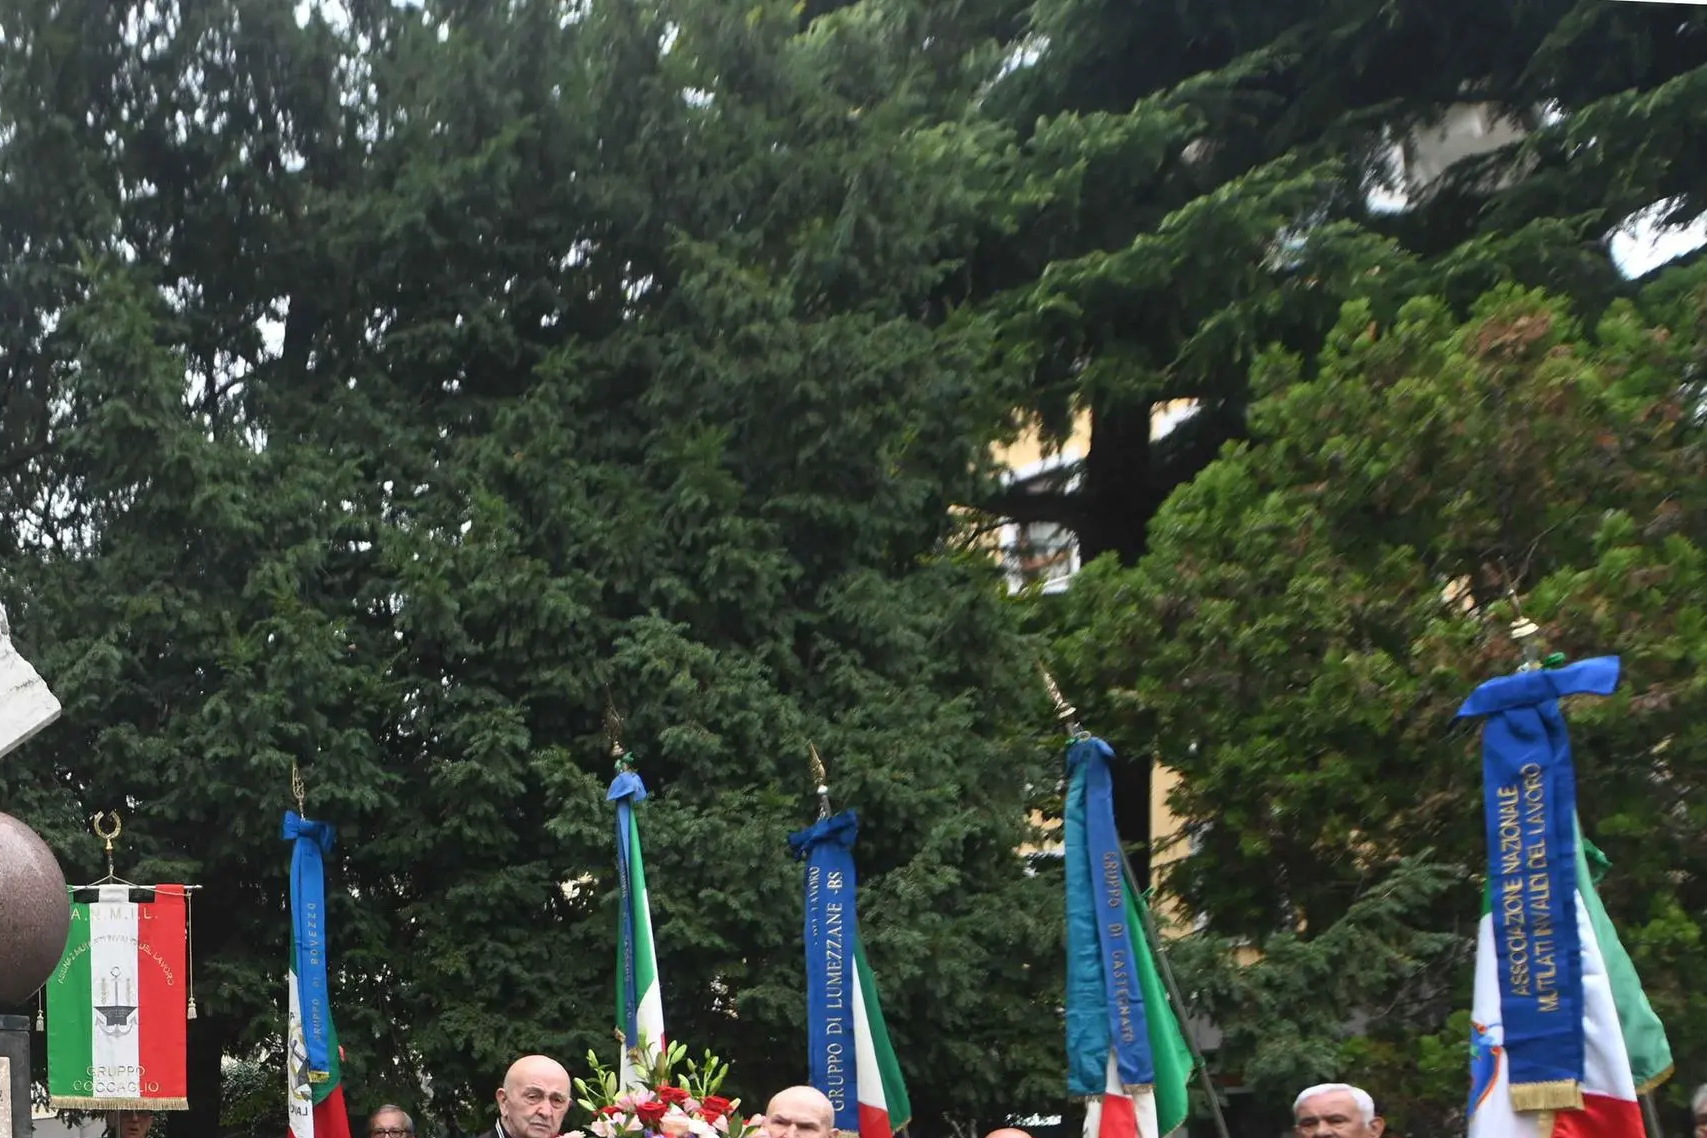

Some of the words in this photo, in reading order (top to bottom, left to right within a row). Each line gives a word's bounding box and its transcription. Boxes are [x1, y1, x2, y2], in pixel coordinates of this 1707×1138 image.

[1497, 784, 1522, 875] NAZIONALE
[1520, 763, 1545, 835] LAVORO
[1103, 852, 1121, 907] GRUPPO
[1526, 837, 1547, 869] DEL
[826, 902, 843, 1009] LUMEZZANE
[1108, 923, 1123, 938] DI
[1502, 878, 1531, 996] ASSOCIAZIONE
[1534, 940, 1559, 1012] MUTILATI
[827, 1018, 842, 1035] DI
[73, 1080, 160, 1093] COCCAGLIO
[86, 1065, 145, 1078] GRUPPO
[826, 1042, 844, 1112] GRUPPO
